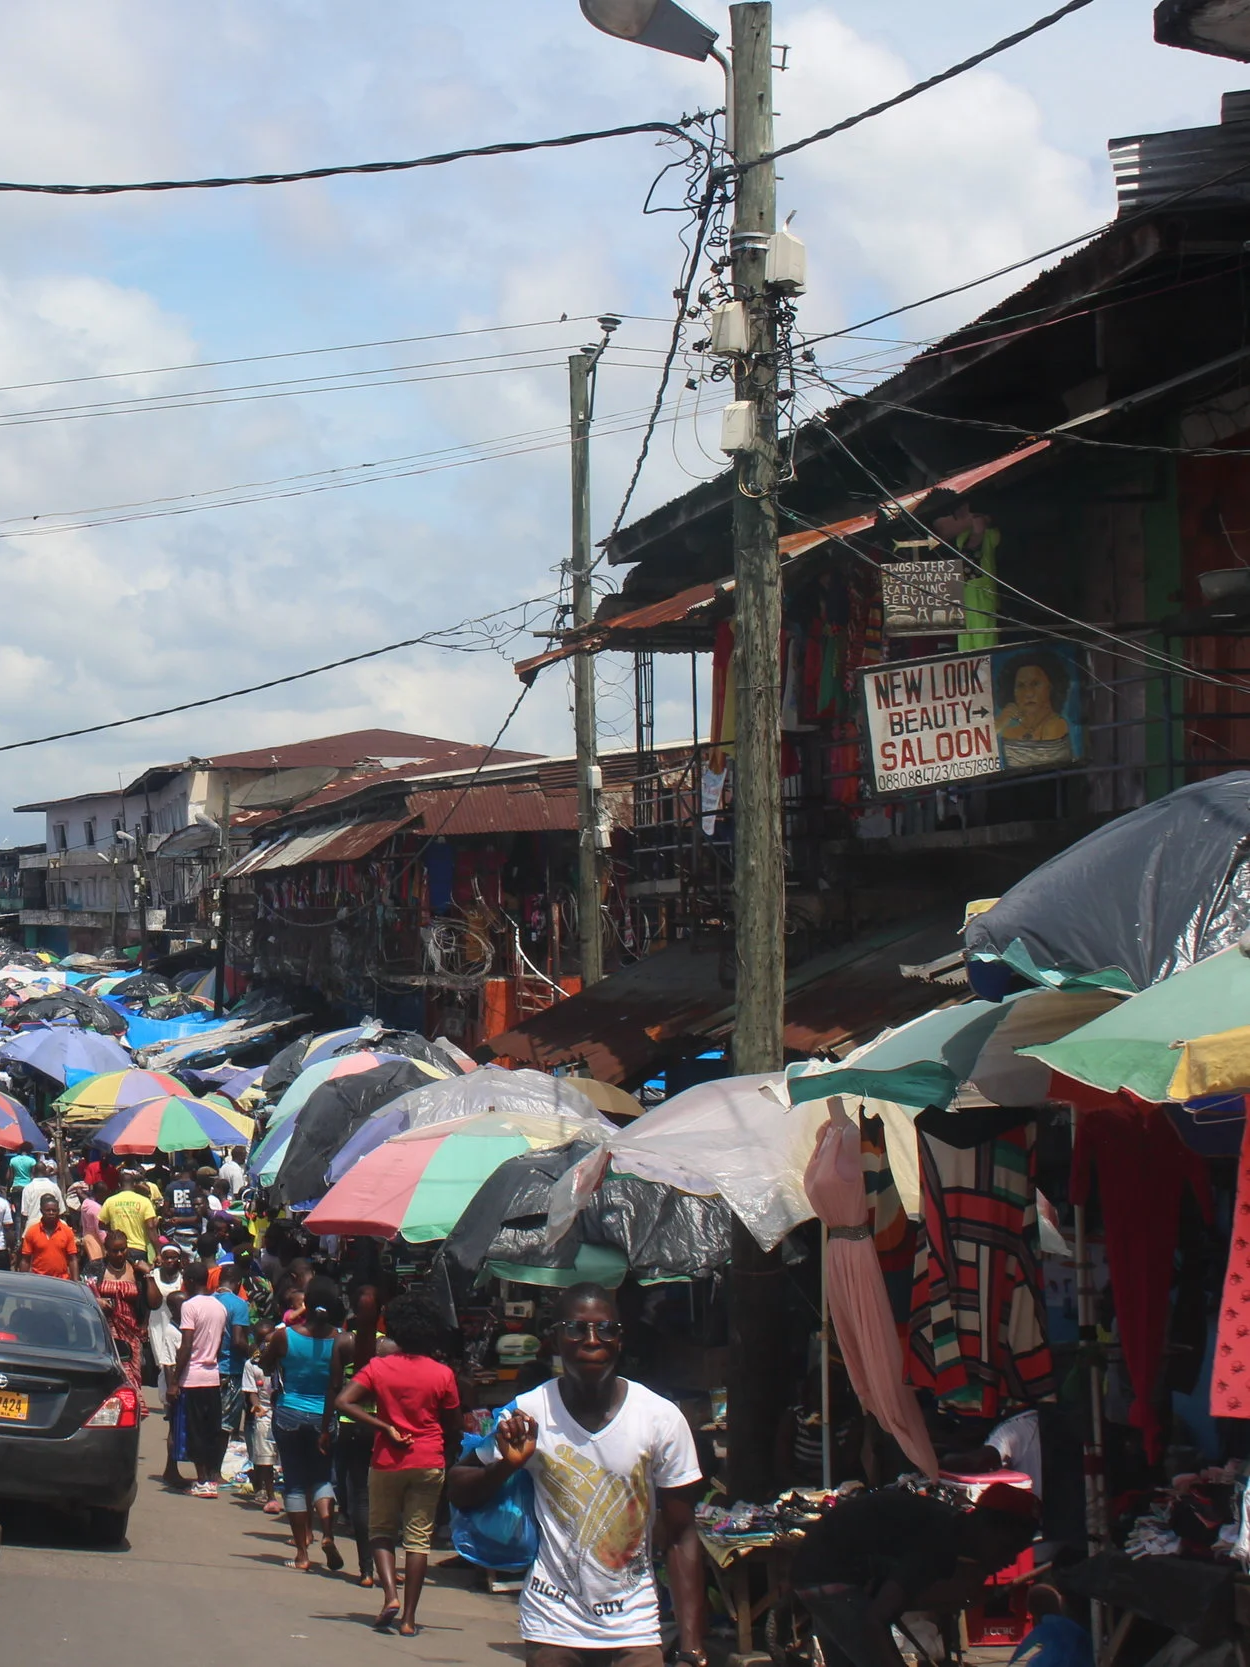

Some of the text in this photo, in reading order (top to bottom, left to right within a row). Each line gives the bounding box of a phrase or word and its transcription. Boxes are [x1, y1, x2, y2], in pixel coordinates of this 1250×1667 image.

[883, 594, 951, 606] SERVICES
[874, 668, 923, 710] NEW
[889, 700, 972, 737] BEAUTY
[880, 725, 992, 771] SALOON
[173, 1189, 192, 1204] BE
[530, 1575, 625, 1617] RICH GUY
